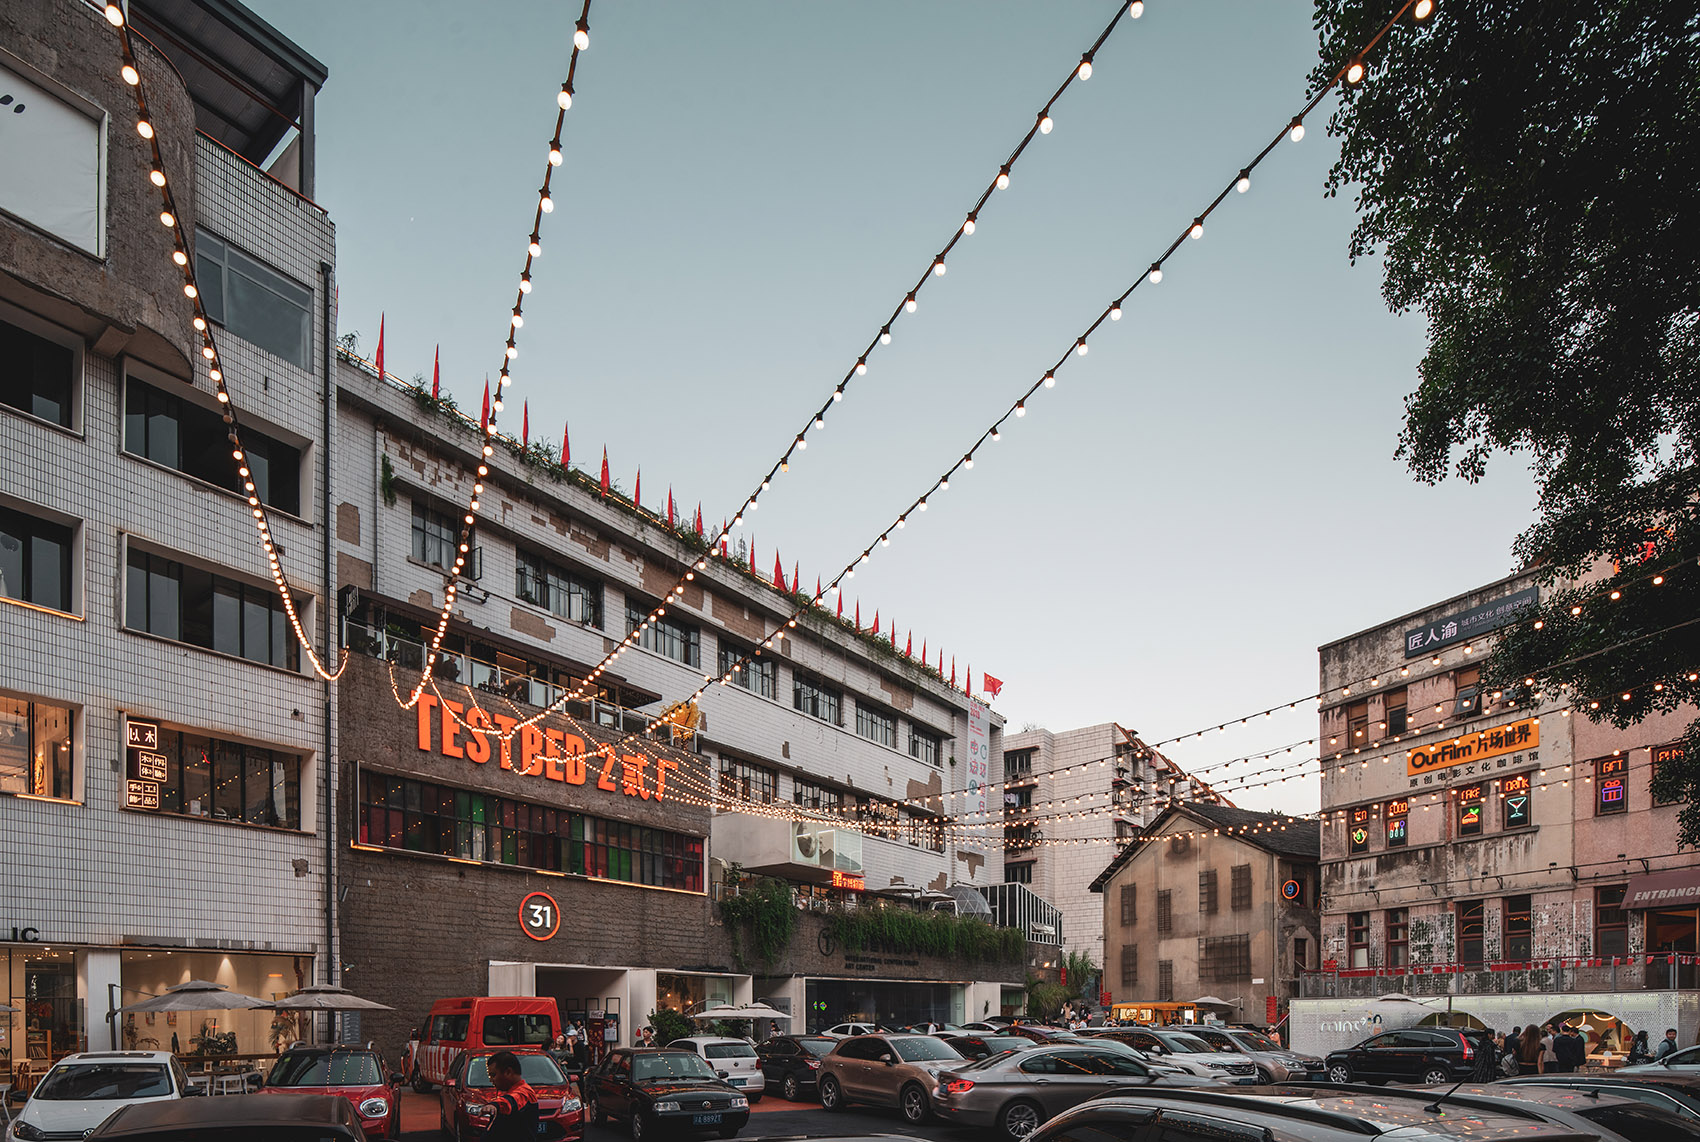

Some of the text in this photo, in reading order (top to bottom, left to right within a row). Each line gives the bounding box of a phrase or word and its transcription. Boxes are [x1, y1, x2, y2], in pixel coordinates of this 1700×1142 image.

[129, 727, 155, 743] 以木
[411, 690, 588, 786] TESTBED
[1476, 723, 1532, 754] 片场世界
[1409, 751, 1539, 788] 原创电影文化咖啡馆
[1287, 885, 1294, 895] 9
[529, 904, 551, 928] 31
